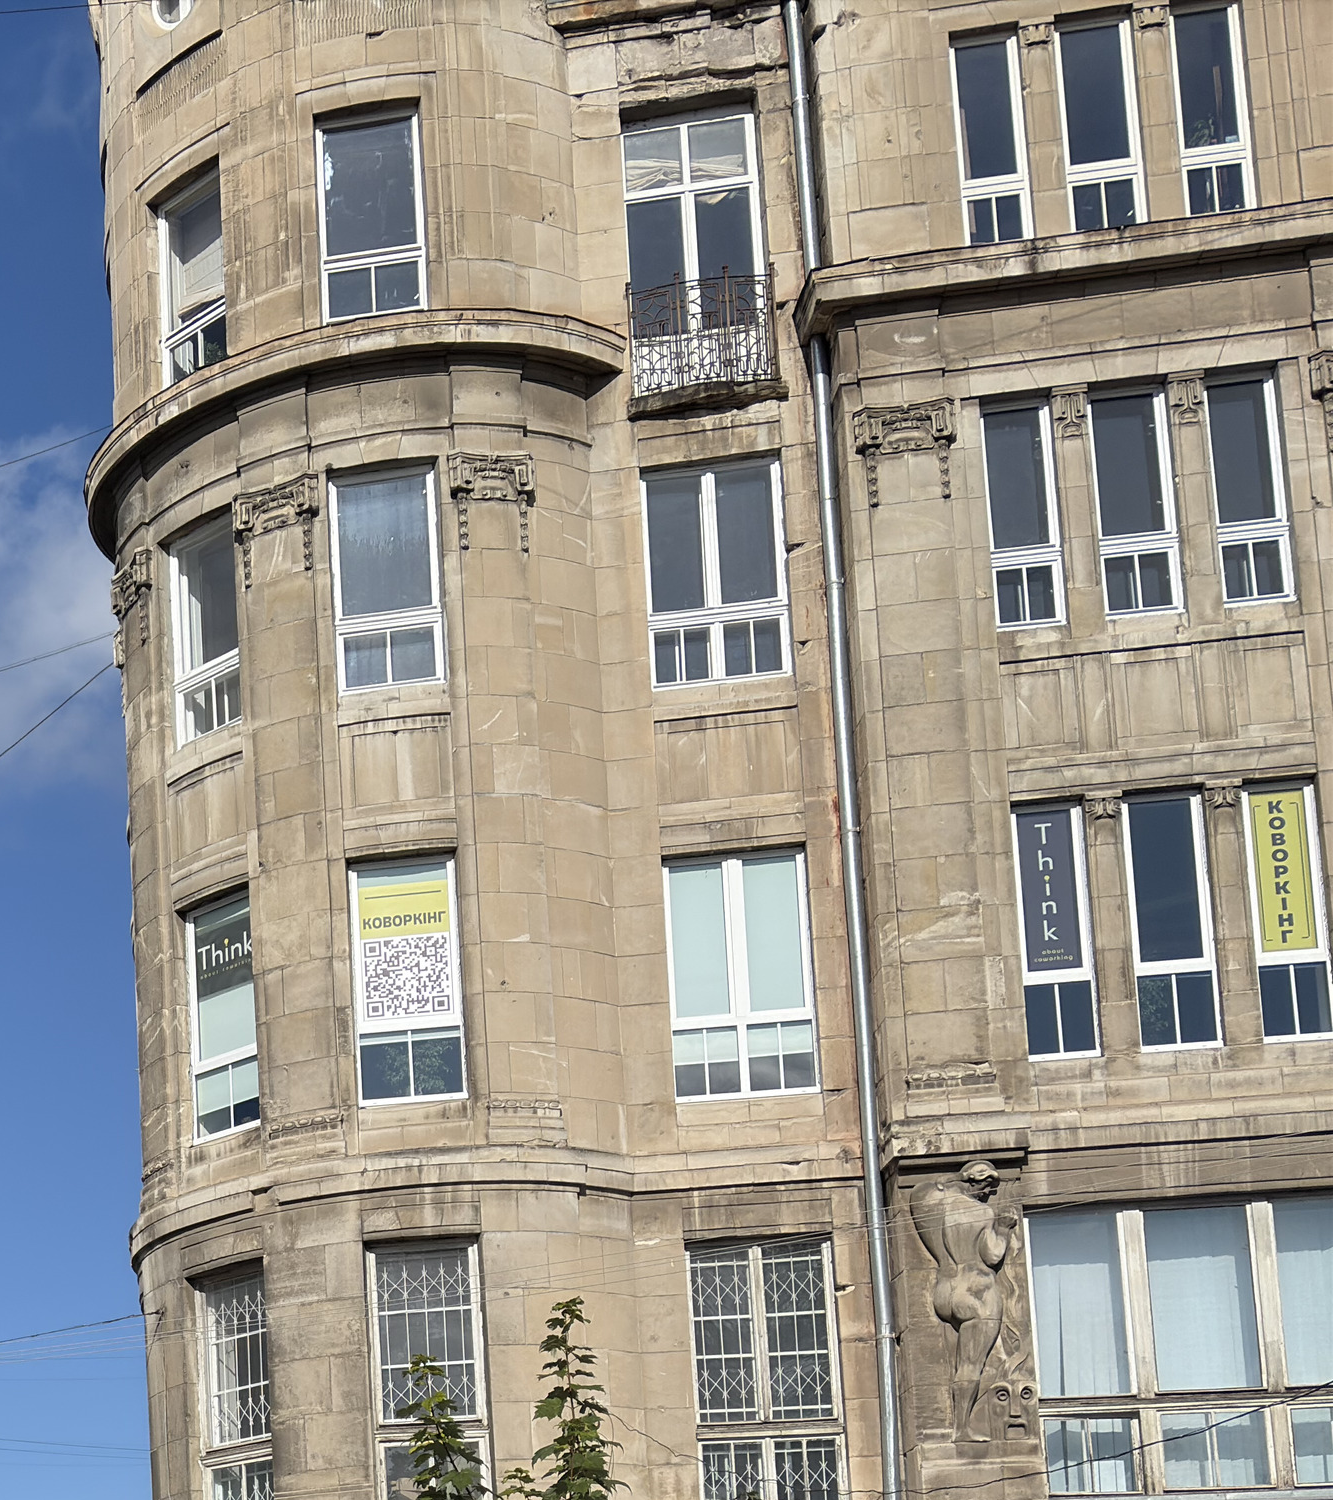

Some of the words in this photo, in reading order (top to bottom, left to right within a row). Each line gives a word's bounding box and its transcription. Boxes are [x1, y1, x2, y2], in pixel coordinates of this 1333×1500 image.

[1034, 823, 1059, 941] Think
[1268, 800, 1294, 943] КОВОРКІНГ
[363, 911, 446, 930] КОВОРКІНГ
[197, 931, 252, 970] Think
[1034, 954, 1074, 962] coworking
